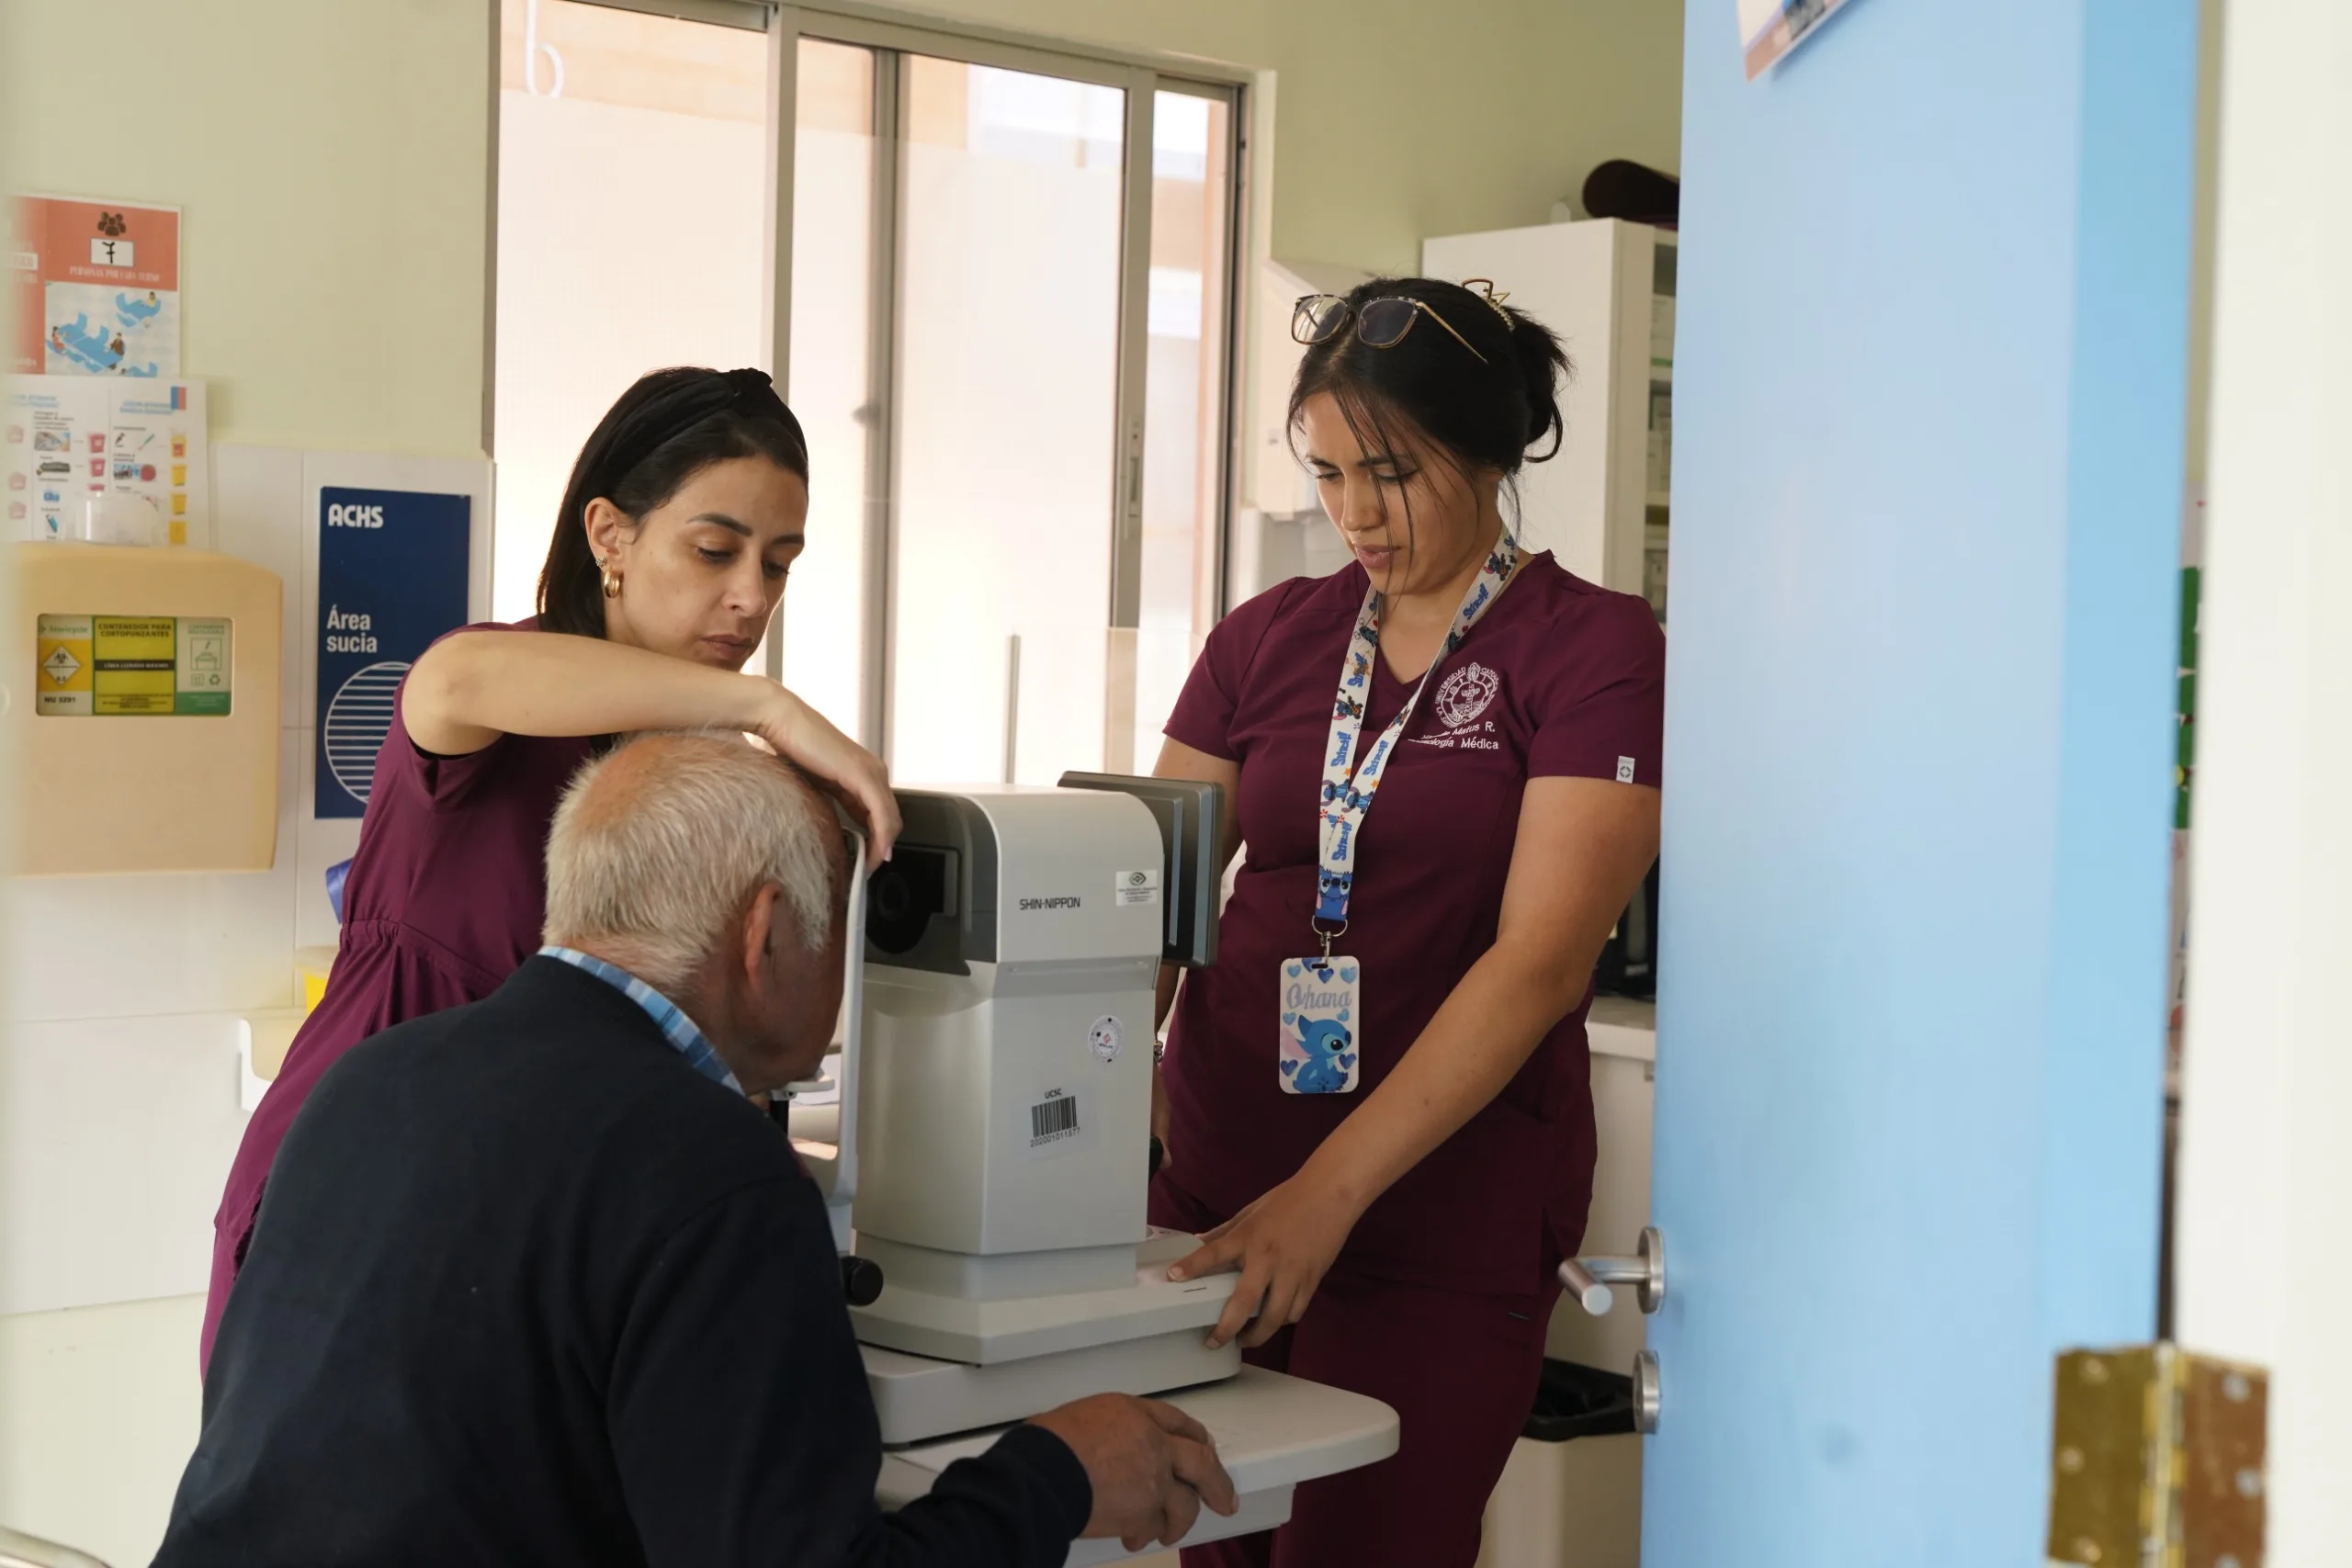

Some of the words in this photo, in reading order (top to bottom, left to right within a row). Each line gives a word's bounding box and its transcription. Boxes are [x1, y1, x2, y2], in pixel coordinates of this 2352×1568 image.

[328, 503, 384, 528] ACHS
[326, 604, 371, 630] Área
[326, 632, 378, 653] sucia
[1485, 721, 1496, 732] R.
[1460, 736, 1499, 750] Médica
[1019, 897, 1081, 910] SHIN-NIPPON
[1286, 982, 1352, 1010] Ohana
